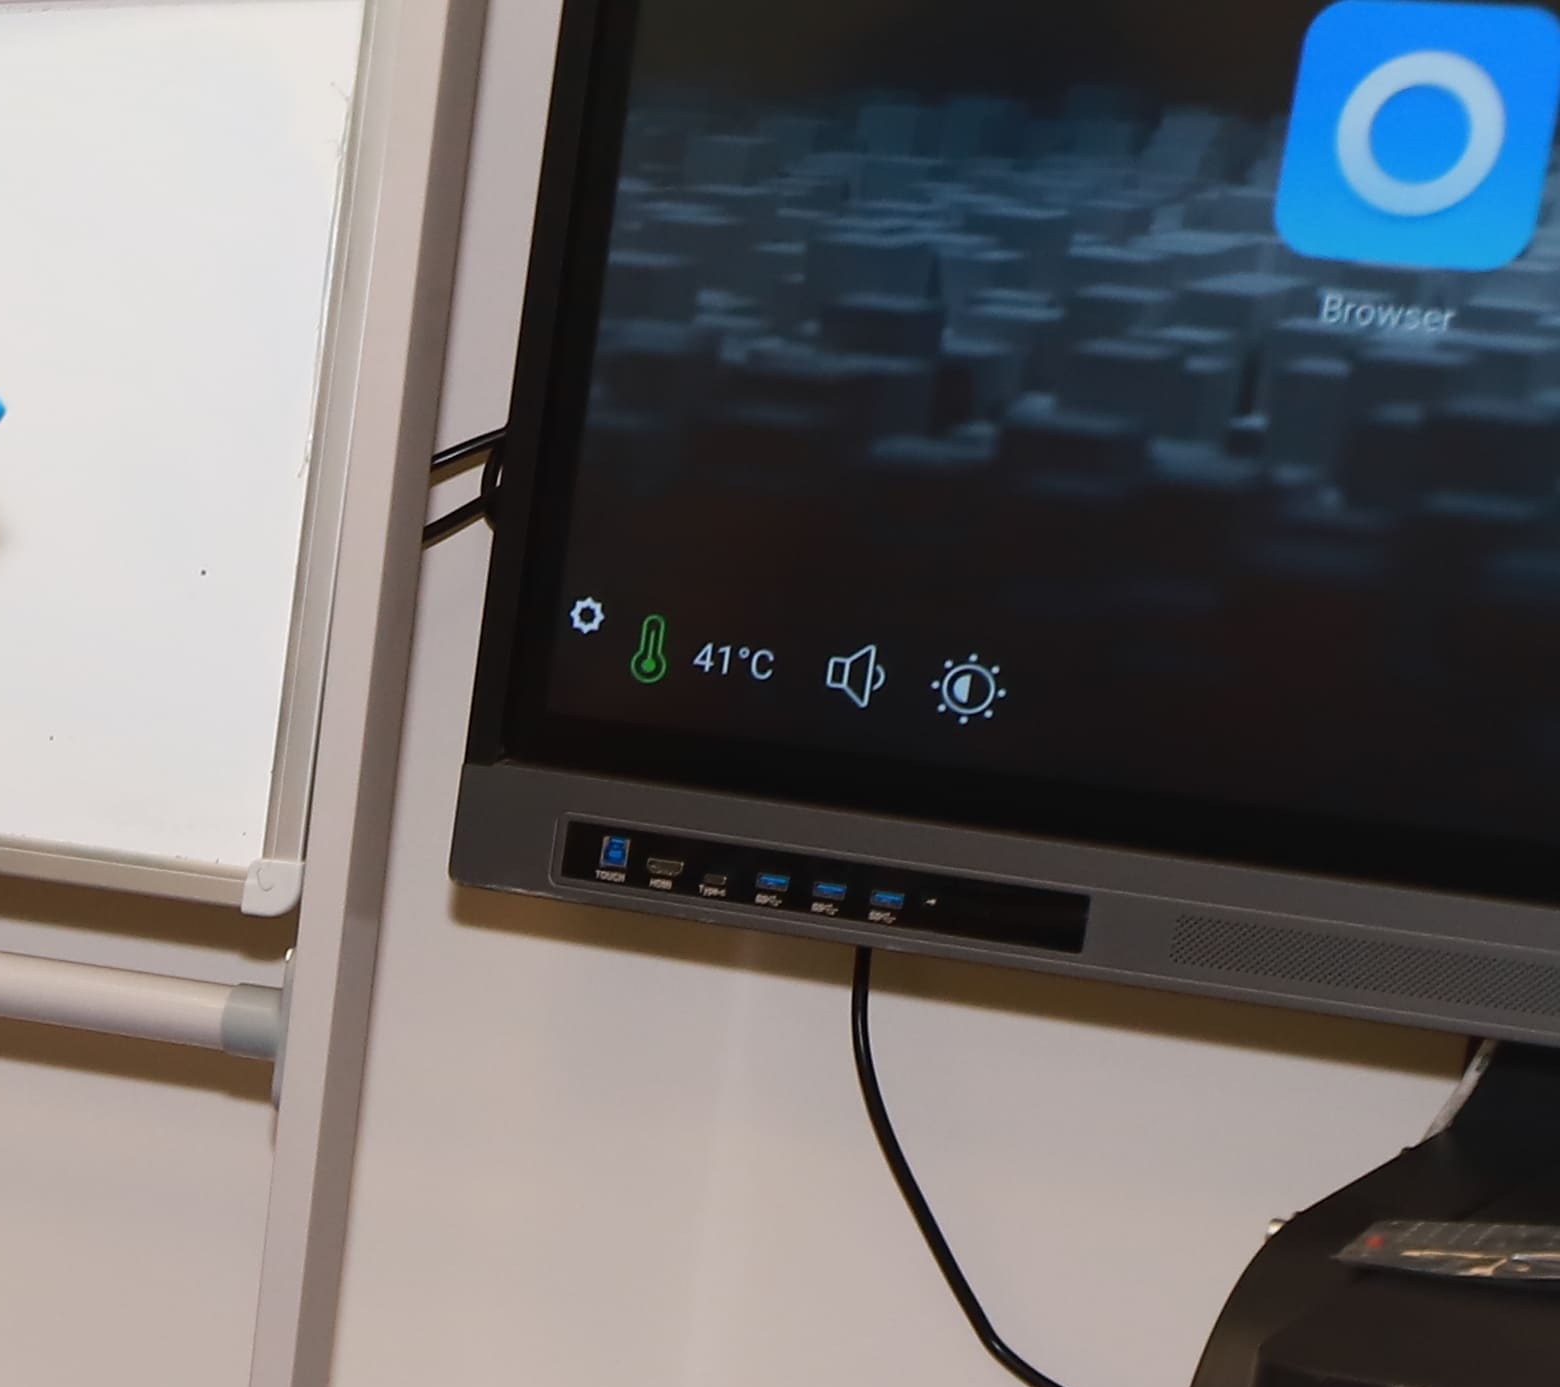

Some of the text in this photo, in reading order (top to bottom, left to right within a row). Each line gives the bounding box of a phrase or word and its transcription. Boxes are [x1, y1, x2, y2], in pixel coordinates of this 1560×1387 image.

[1322, 293, 1456, 332] Browser
[692, 642, 775, 681] 41°C
[595, 869, 626, 883] TOUCH
